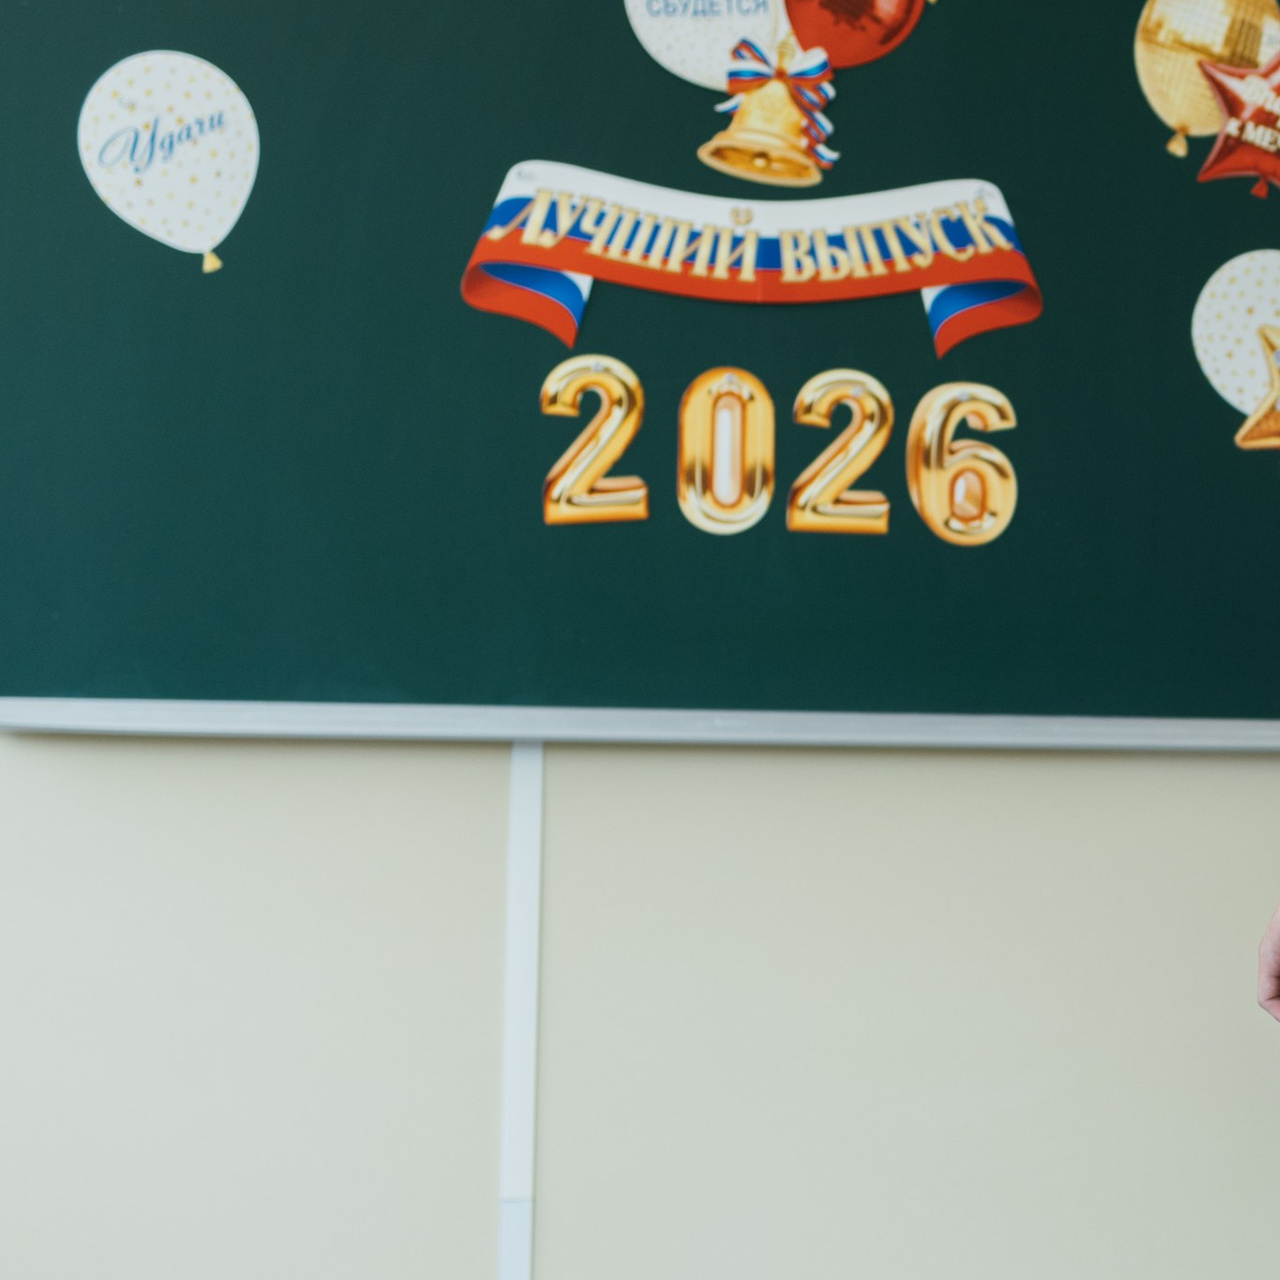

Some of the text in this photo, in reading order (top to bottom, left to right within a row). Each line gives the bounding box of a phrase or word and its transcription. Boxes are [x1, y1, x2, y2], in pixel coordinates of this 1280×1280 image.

[98, 110, 225, 173] Удачи
[487, 186, 1015, 284] ЛУЧШИЙ ВЫПУСК
[539, 353, 1018, 547] 2026
